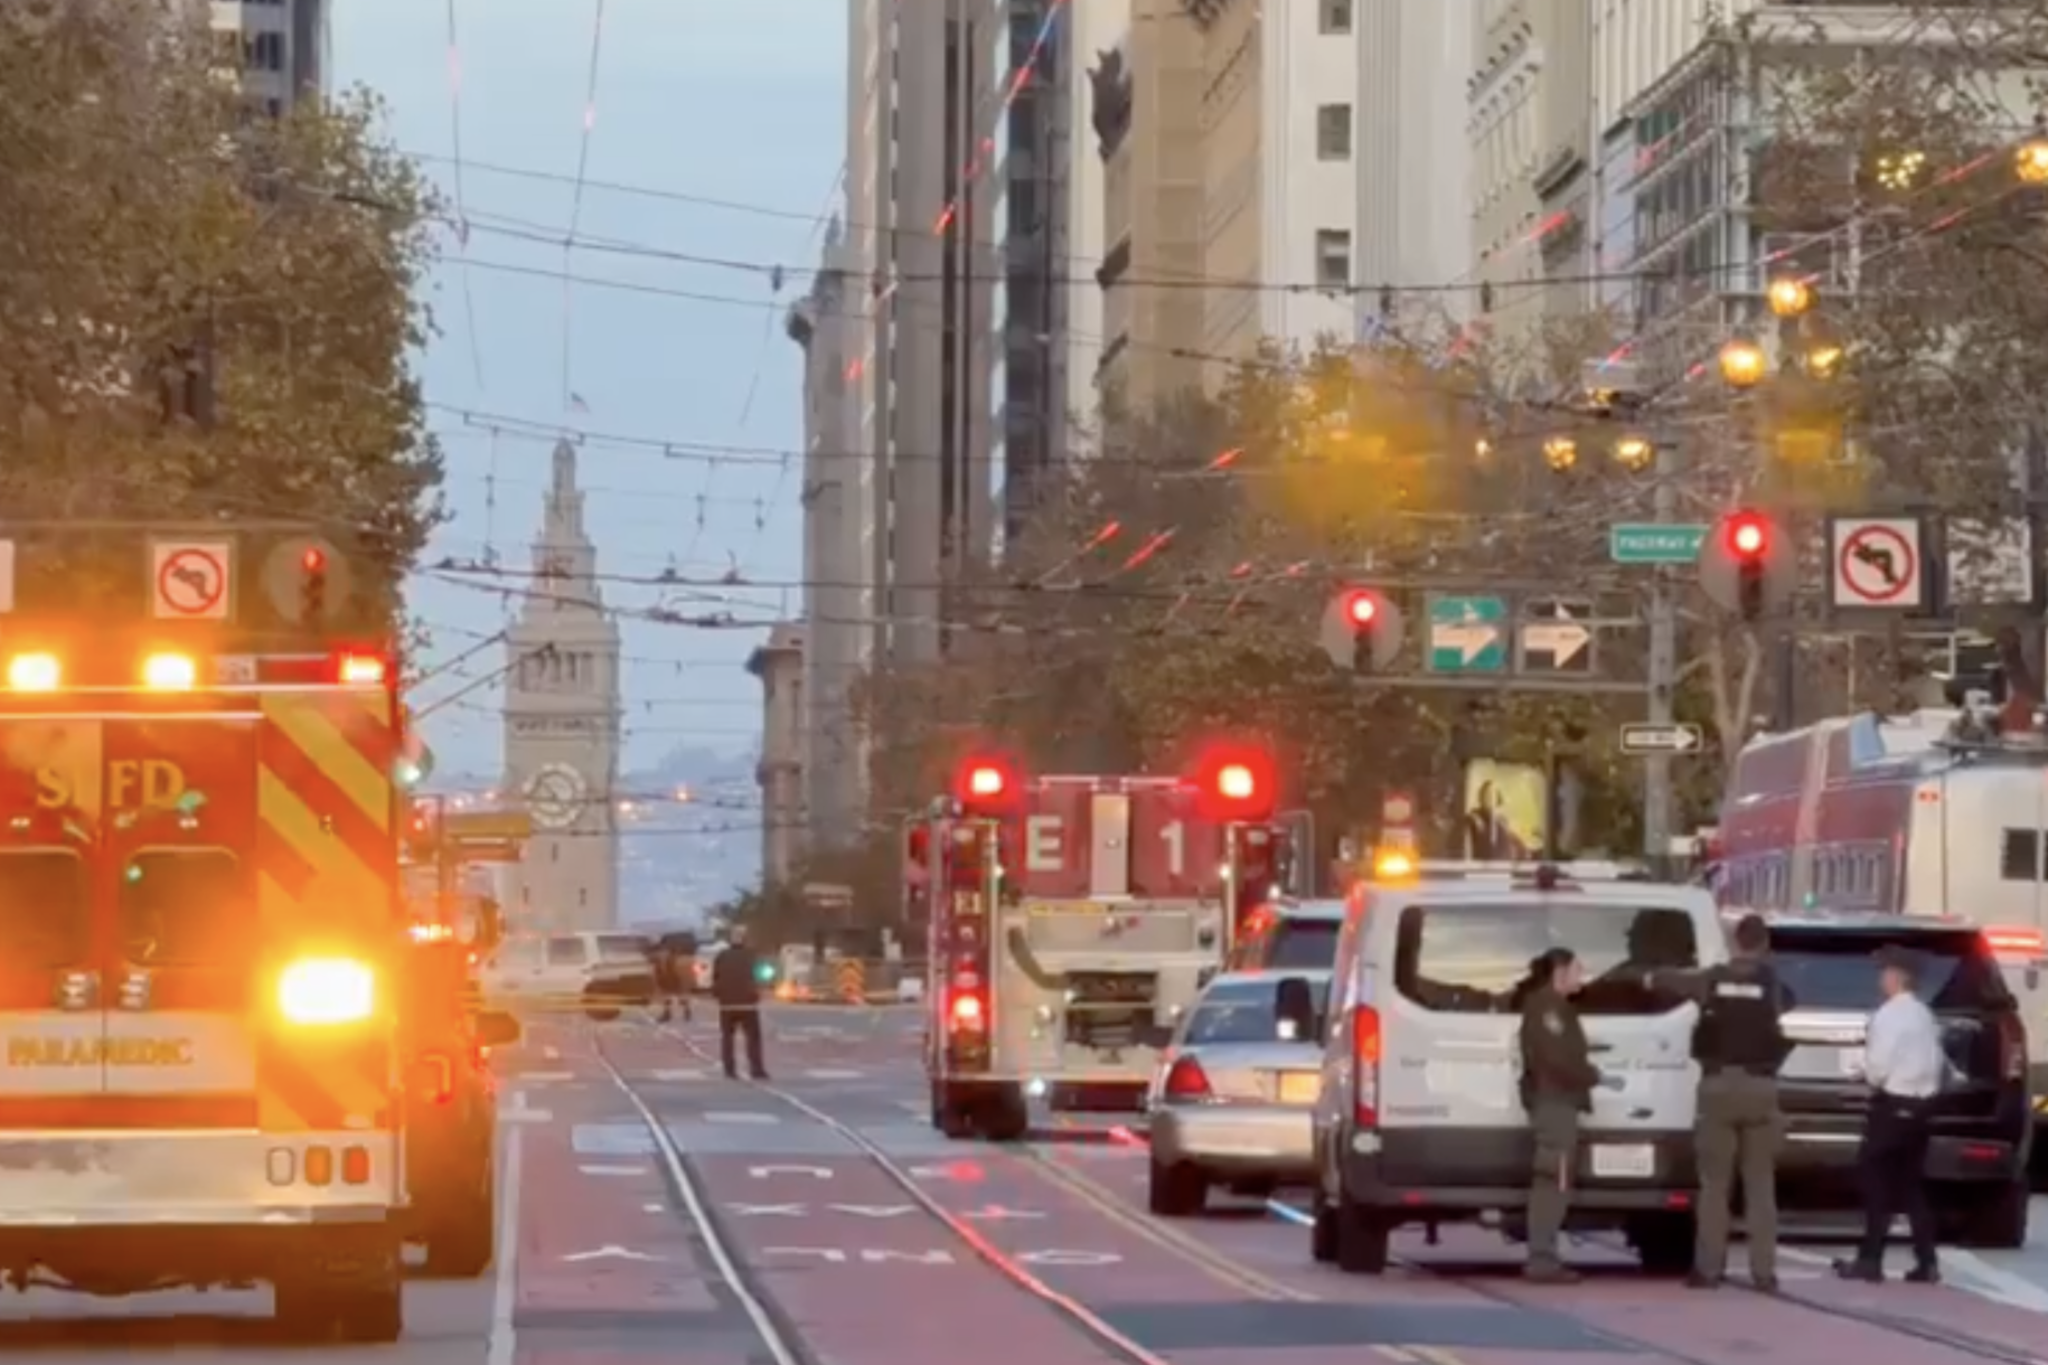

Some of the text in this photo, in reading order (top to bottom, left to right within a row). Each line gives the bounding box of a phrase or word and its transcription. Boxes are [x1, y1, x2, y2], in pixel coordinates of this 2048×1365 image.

[1027, 816, 1184, 873] E 1
[8, 1036, 194, 1066] PARAMEDIC
